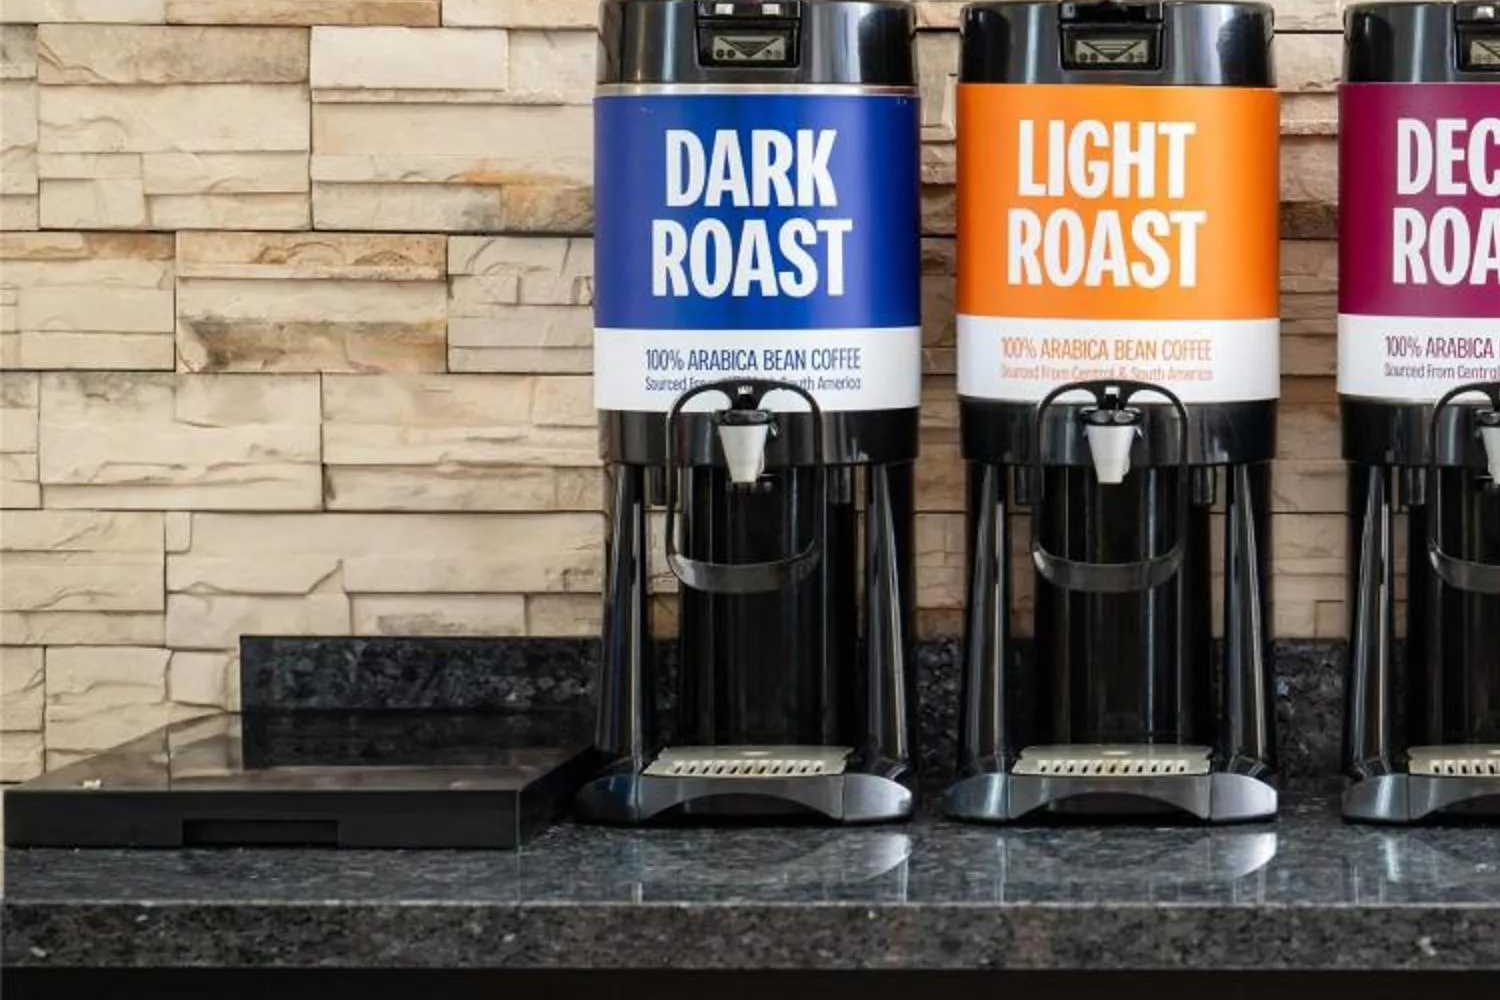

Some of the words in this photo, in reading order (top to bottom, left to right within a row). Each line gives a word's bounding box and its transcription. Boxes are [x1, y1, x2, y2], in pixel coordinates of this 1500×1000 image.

[666, 129, 838, 207] DARK
[1018, 119, 1196, 198] LIGHT
[652, 218, 853, 297] ROAST
[1008, 208, 1207, 288] ROAST
[1001, 337, 1036, 359] 100%
[1040, 338, 1109, 360] ARABICA
[1114, 339, 1157, 360] BEAN
[1161, 339, 1213, 361] COFFEE
[1385, 335, 1422, 357] 100%
[1425, 337, 1494, 358] ARABICA
[645, 348, 684, 371] 100%
[687, 349, 759, 371] ARABICA
[763, 349, 807, 371] BEAN
[811, 347, 861, 370] COFFEE
[645, 376, 687, 391] Sourced
[817, 376, 861, 391] America
[1131, 366, 1164, 381] South
[1384, 363, 1425, 378] Sourced
[1427, 364, 1455, 379] From
[1457, 364, 1500, 380] Central
